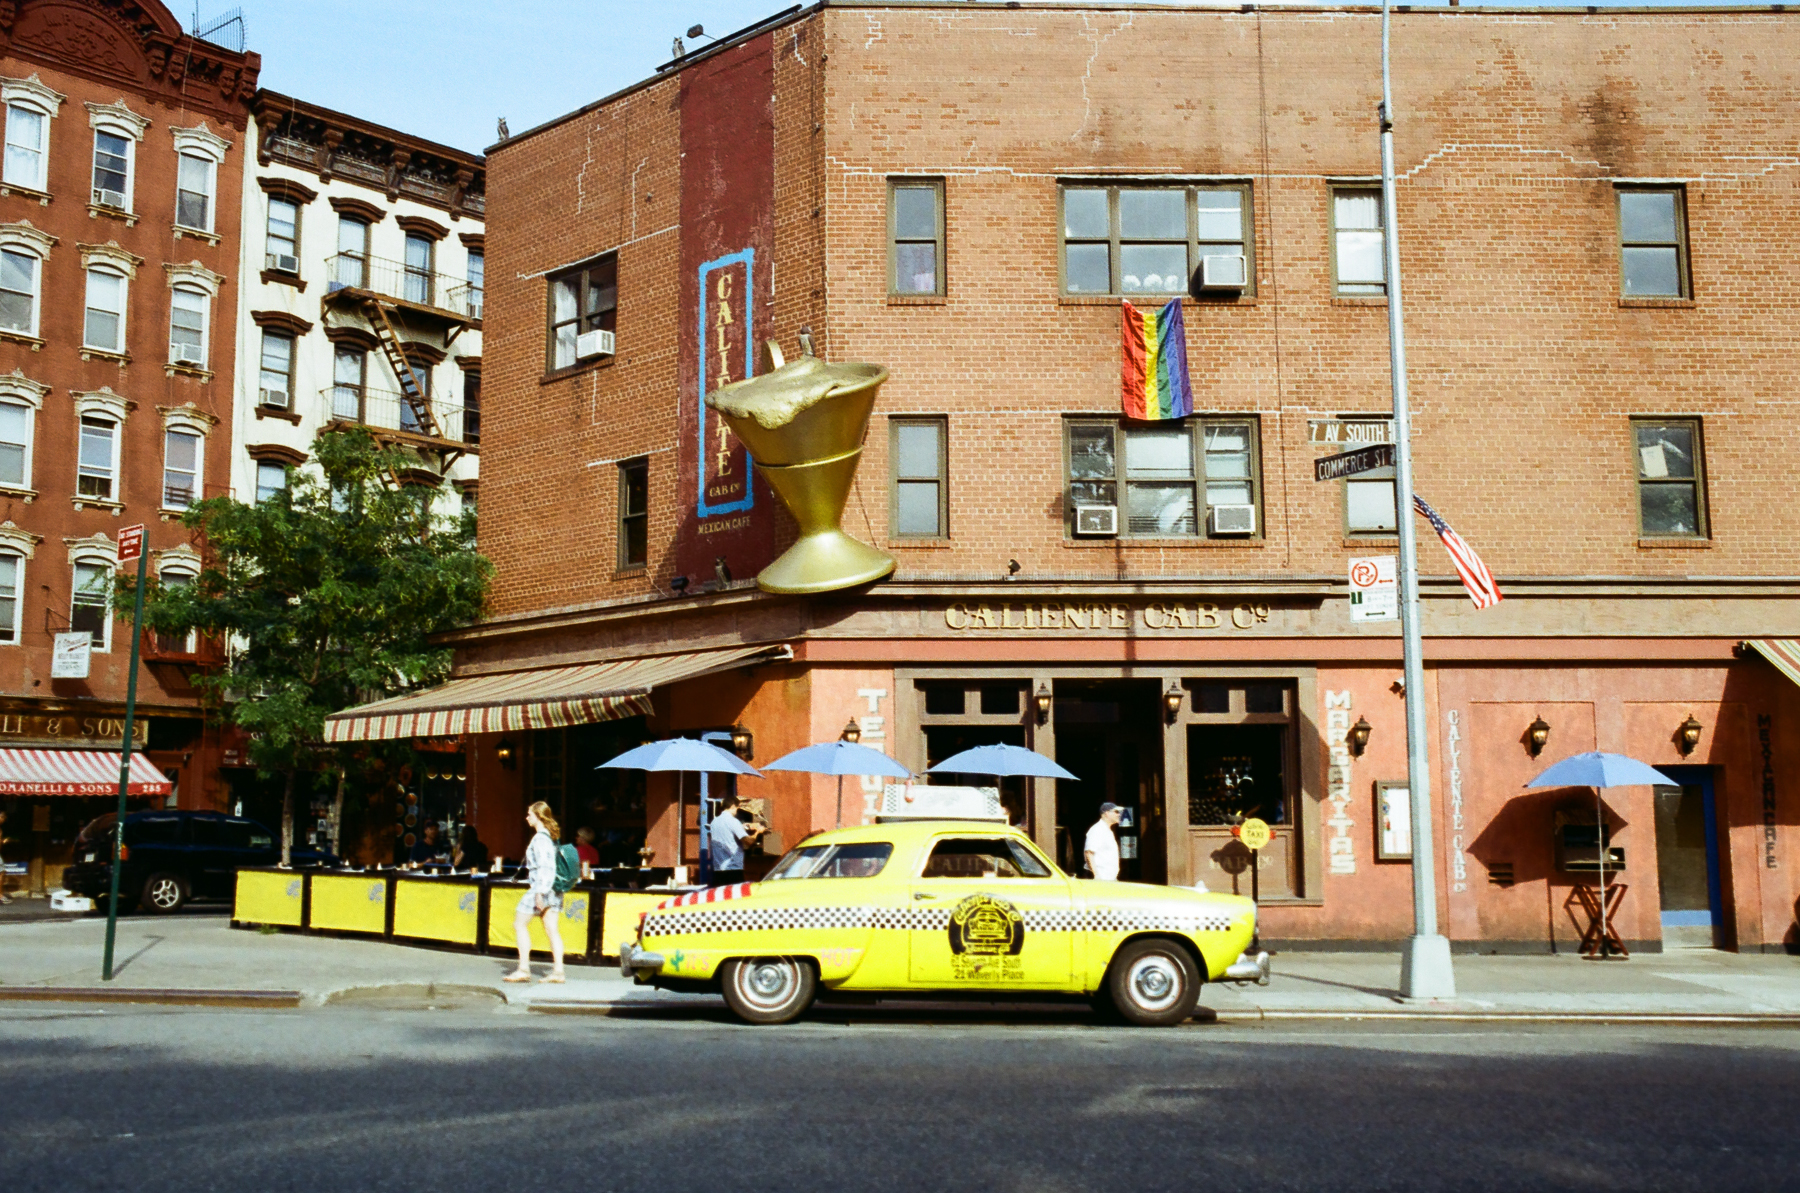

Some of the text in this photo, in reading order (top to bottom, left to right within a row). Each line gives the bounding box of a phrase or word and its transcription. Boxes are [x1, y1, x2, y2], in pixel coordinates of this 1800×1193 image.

[1309, 423, 1384, 443] 7 AV SOUTH
[1318, 452, 1368, 480] COMMERCE
[1374, 448, 1386, 468] ST
[709, 482, 728, 498] CAB
[698, 515, 751, 535] MEXICAN CAFE
[944, 602, 1132, 630] CALIENTE
[1144, 602, 1221, 630] CAB
[46, 717, 62, 736] &
[1447, 709, 1464, 831] CALIENTE
[66, 784, 75, 793] &
[79, 784, 113, 793] SONS
[1757, 713, 1778, 869] MEXICAN CAFE
[1452, 834, 1466, 881] CAB
[820, 947, 855, 968] HOT
[1002, 970, 1024, 980] Place
